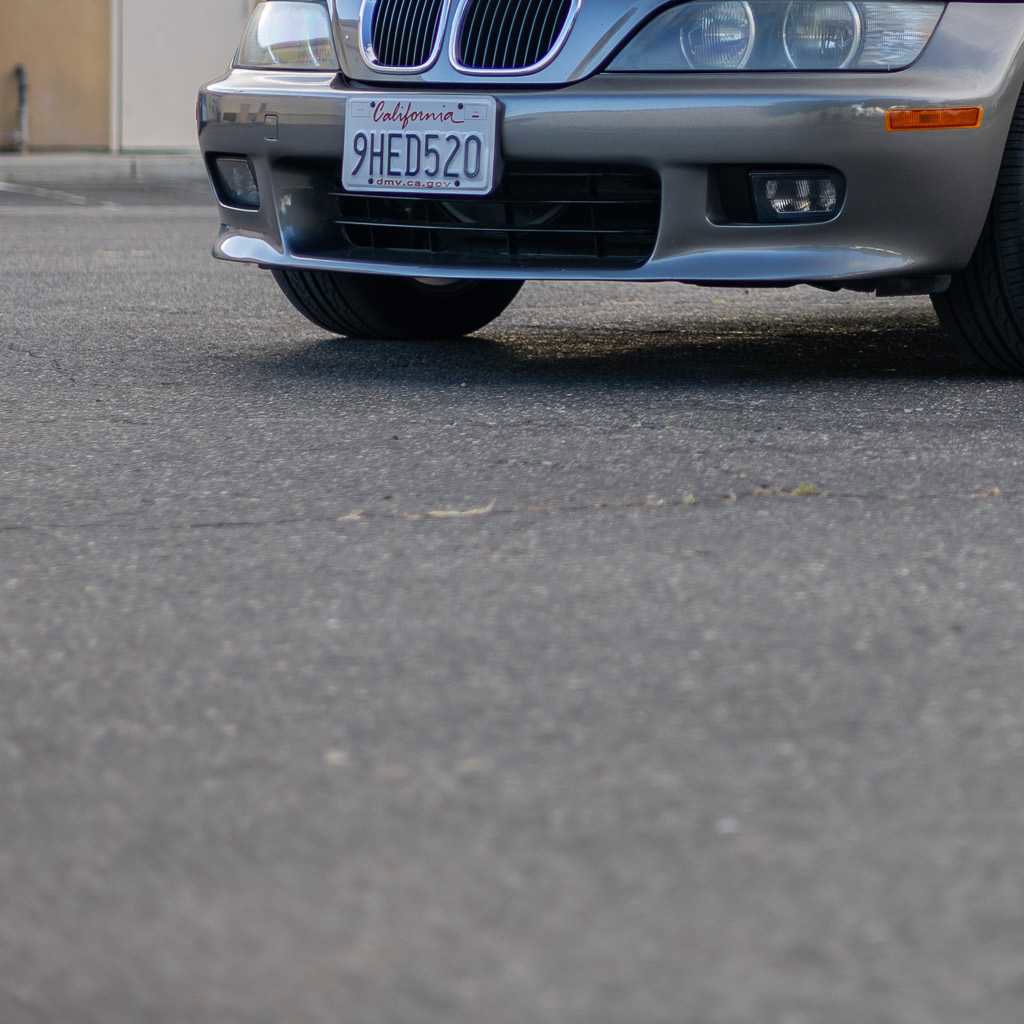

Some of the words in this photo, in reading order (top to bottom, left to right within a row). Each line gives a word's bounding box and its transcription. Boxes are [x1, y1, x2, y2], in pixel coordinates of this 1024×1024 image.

[373, 100, 465, 129] California
[351, 132, 482, 179] 9HED520
[376, 178, 452, 189] dmv.ca.gov
